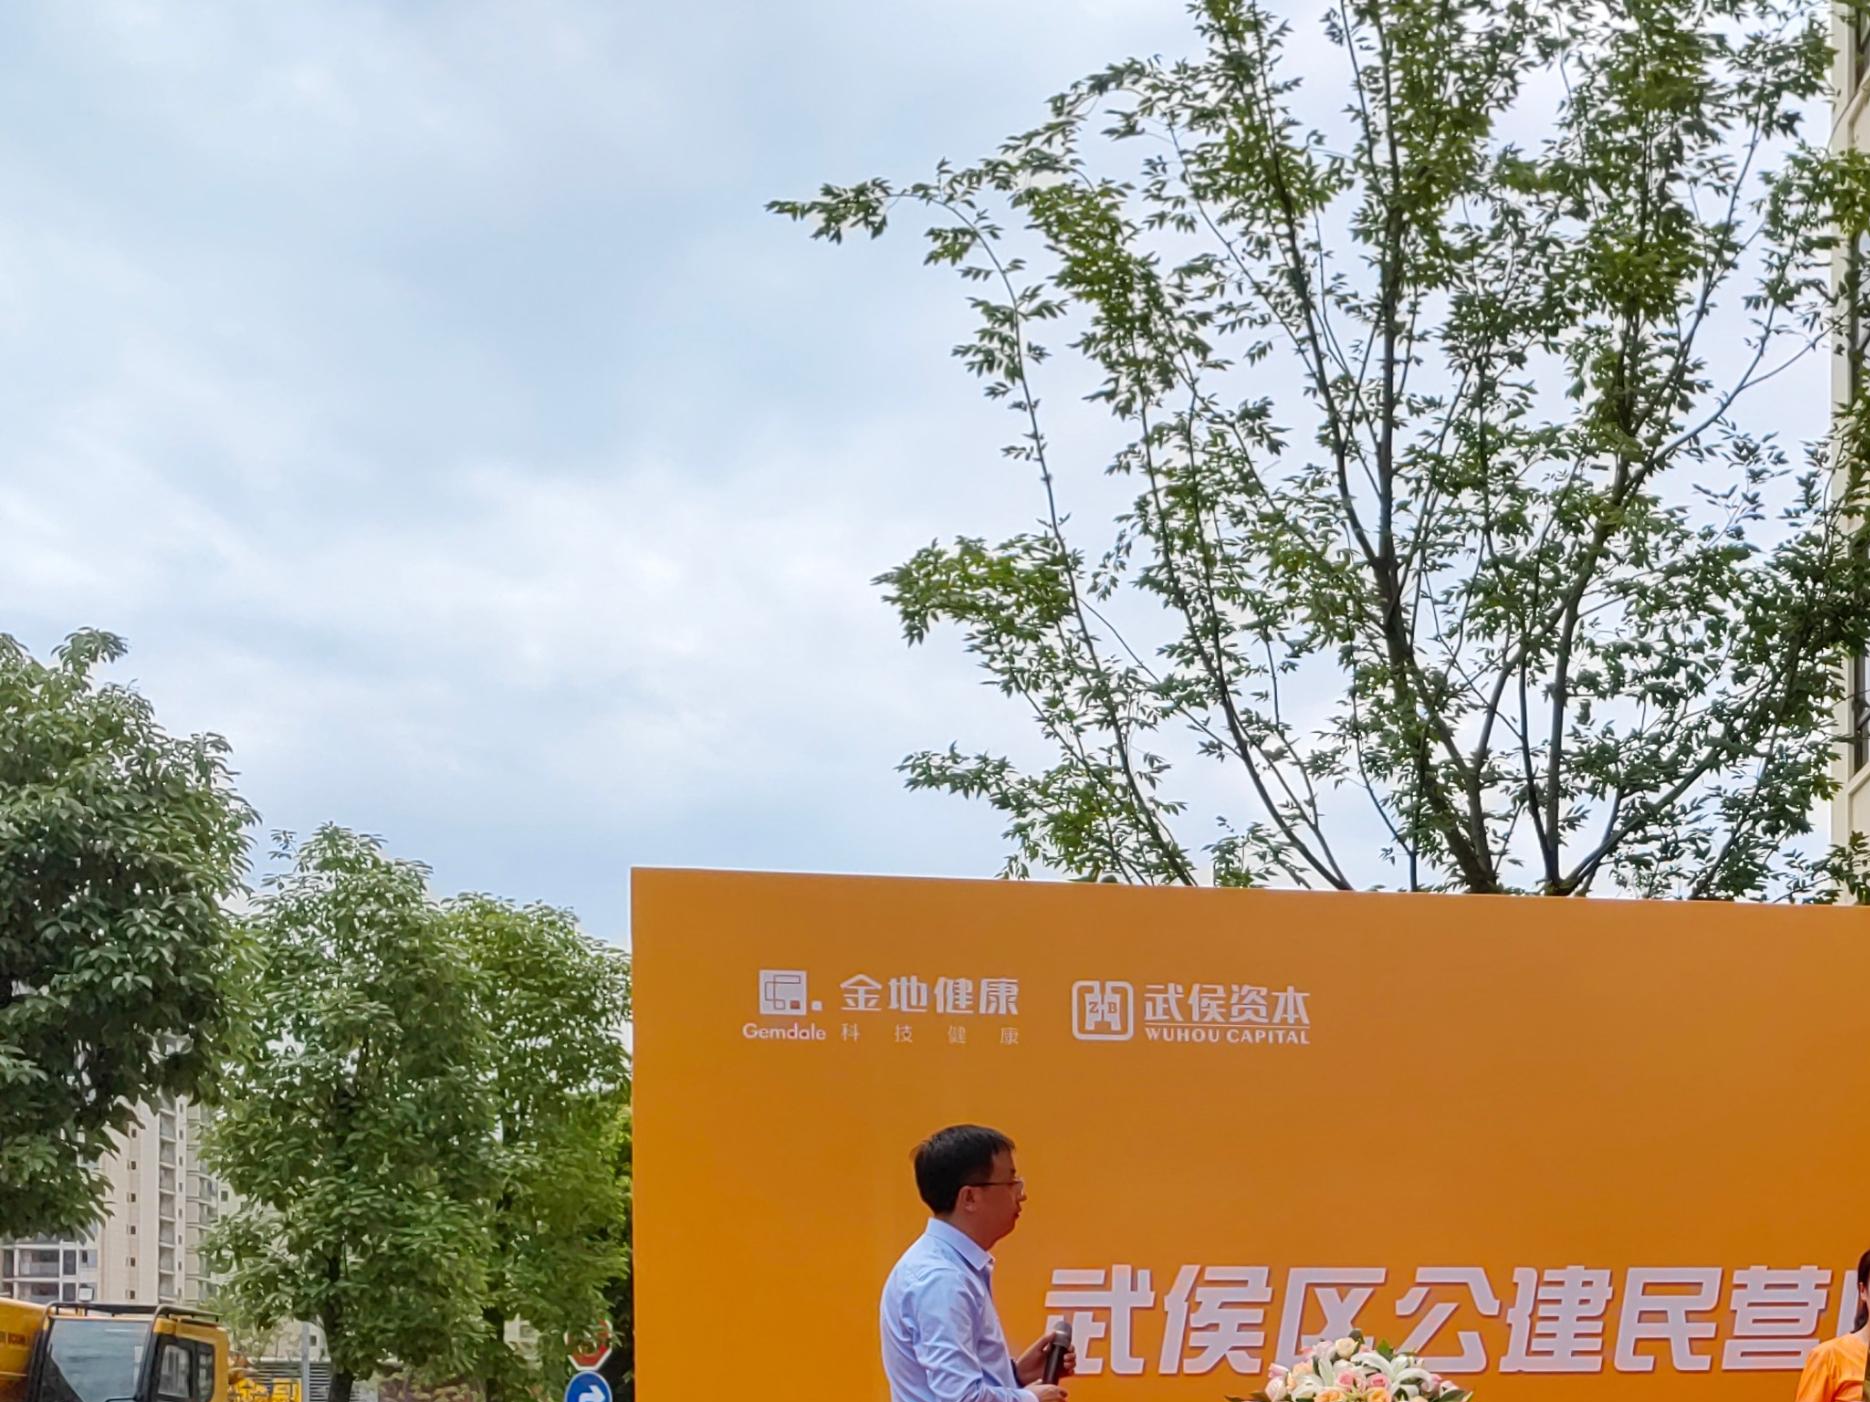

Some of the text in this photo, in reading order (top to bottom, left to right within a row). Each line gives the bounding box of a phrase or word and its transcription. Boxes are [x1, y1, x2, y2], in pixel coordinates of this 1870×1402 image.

[840, 974, 1019, 1015] 金地健康
[1144, 983, 1310, 1024] 武侯资本
[742, 1023, 827, 1041] Gemdale
[840, 1024, 1019, 1045] 科技健康
[1145, 1028, 1311, 1045] WUHOU CAPITAL
